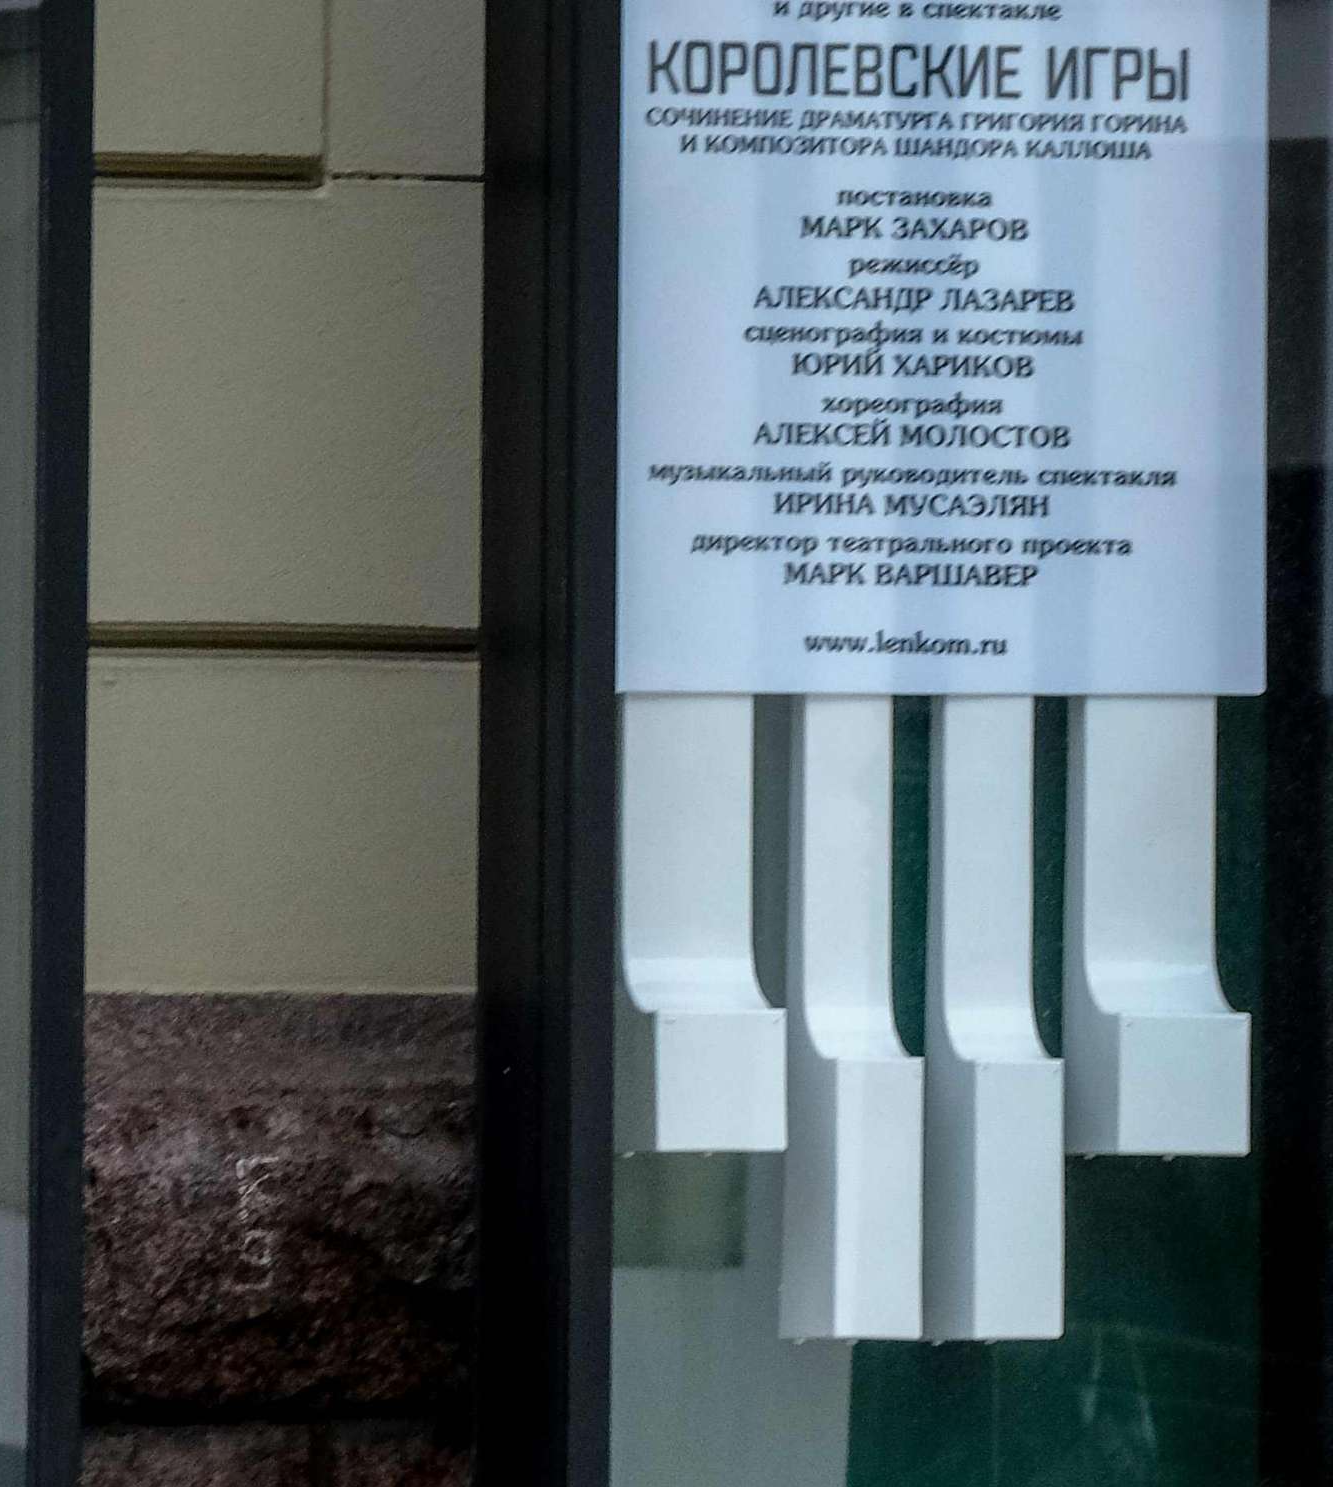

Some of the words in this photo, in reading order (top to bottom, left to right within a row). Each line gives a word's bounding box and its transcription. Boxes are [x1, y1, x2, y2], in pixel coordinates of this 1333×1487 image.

[773, 1, 789, 16] и
[797, 1, 890, 22] другие
[899, 3, 914, 18] в
[922, 3, 1062, 21] спектакле
[649, 40, 1022, 99] КОРОЛЕВСКИЕ
[1047, 46, 1189, 102] ИГРЫ
[645, 107, 793, 128] СОЧИНЕНИЕ
[798, 110, 954, 131] ДРАМАТУРГА
[960, 112, 1085, 132] ГРИГОРИЯ
[1091, 114, 1188, 134] ГОРИНА
[680, 135, 697, 153] И
[705, 135, 888, 156] КОМПОЗИТОРА
[894, 137, 1018, 160] ШАНДОРА
[1025, 140, 1152, 160] КАЛЛОША
[837, 190, 992, 208] постановка
[800, 216, 883, 239] МАРК
[891, 217, 1029, 241] ЗАХАРОВ
[754, 285, 933, 314] АЛЕКСАНДР
[939, 288, 1075, 313] ЛАЗАРЕВ
[744, 320, 923, 347] сценография
[932, 329, 949, 344] и
[957, 329, 1083, 346] костюмы
[792, 345, 884, 376] ЮРИЙ
[893, 354, 1034, 378] ХАРИКОВ
[821, 392, 1003, 419] хореография
[754, 418, 891, 447] АЛЕКСЕЙ
[900, 424, 1071, 449] МОЛОСТОВ
[649, 462, 832, 486] музыкальный
[841, 468, 1029, 488] руководитель
[1037, 470, 1177, 487] спектакля
[774, 492, 876, 515] ИРИНА
[885, 494, 1050, 518] МУСАЭЛЯН
[690, 535, 819, 557] директор
[827, 537, 1013, 558] театрального
[1022, 539, 1133, 560] проекта
[784, 562, 866, 585] МАРК
[875, 563, 1039, 587] ВАРШАВЕР
[804, 630, 1007, 655] www.lenkom.ru
